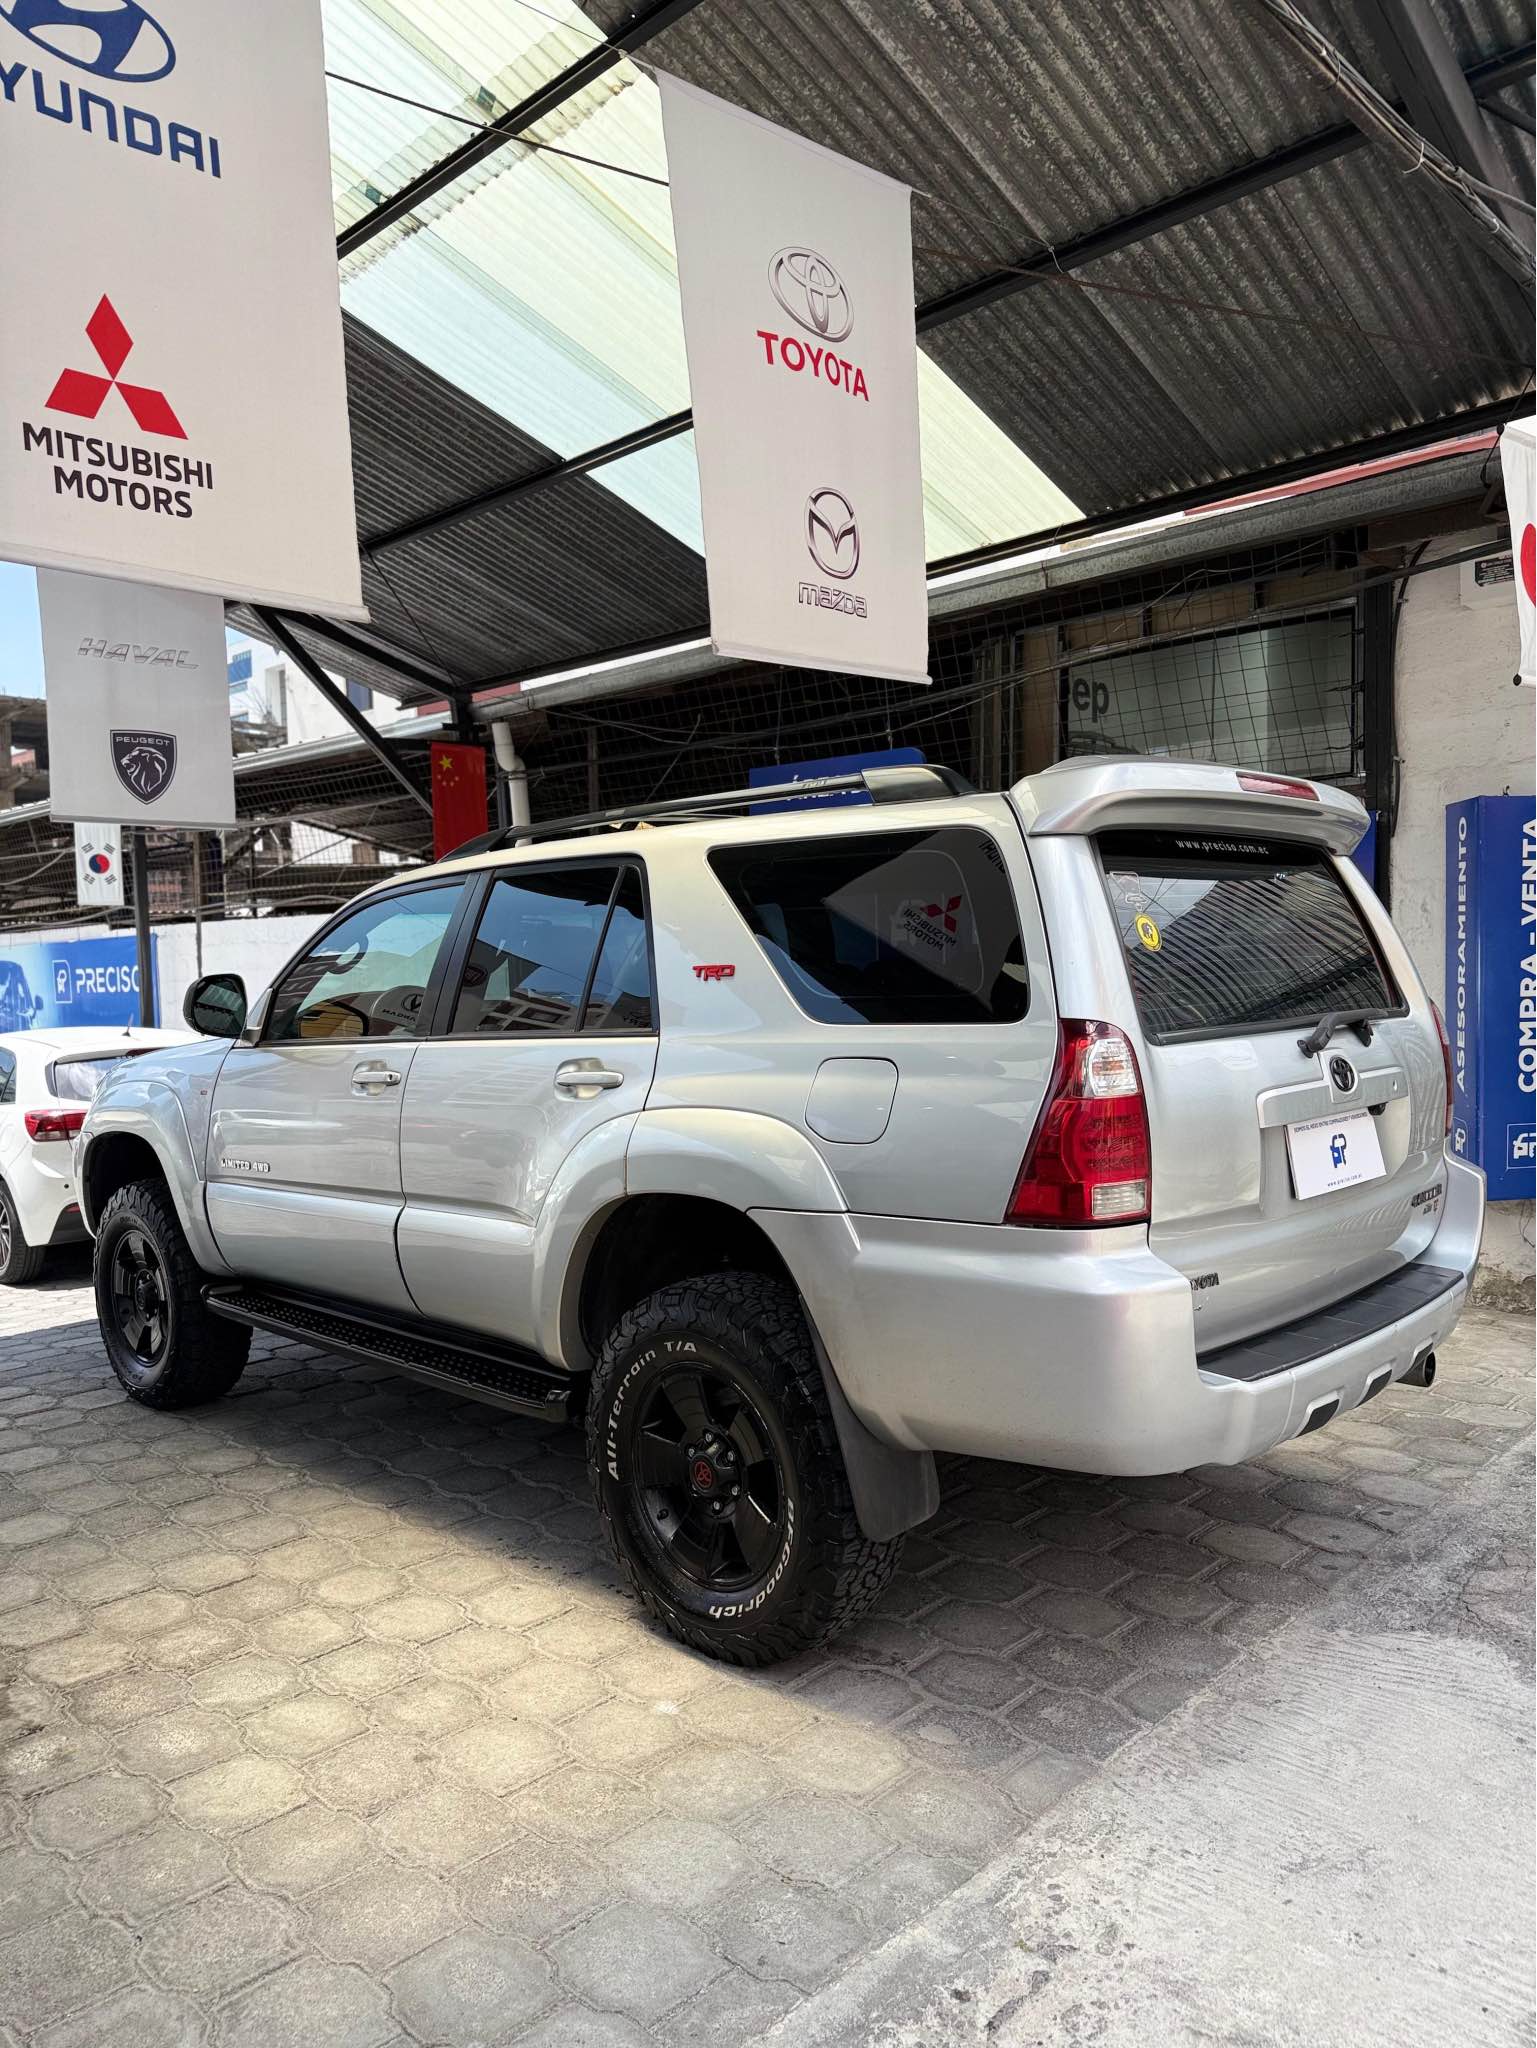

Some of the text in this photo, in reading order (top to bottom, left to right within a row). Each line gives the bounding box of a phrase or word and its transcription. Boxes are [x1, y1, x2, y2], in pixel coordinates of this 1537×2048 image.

[0, 62, 222, 179] YUNDAI
[756, 329, 870, 402] TOYOTA
[22, 421, 214, 490] MITSUBISHI
[54, 465, 193, 519] MOTORS
[78, 637, 199, 670] HAVAL
[115, 736, 171, 747] PEUGEOT
[1175, 839, 1269, 855] www.preciso.com.ec
[1521, 819, 1536, 925] VENTA
[692, 964, 736, 982] TRD
[1455, 816, 1468, 1093] ASESORAMIENTO
[1518, 954, 1536, 1093] COMPRA
[220, 1159, 270, 1173] LIMITED 4WD
[1190, 1272, 1220, 1291] YOTA
[607, 1340, 698, 1481] All-Terrain T/A
